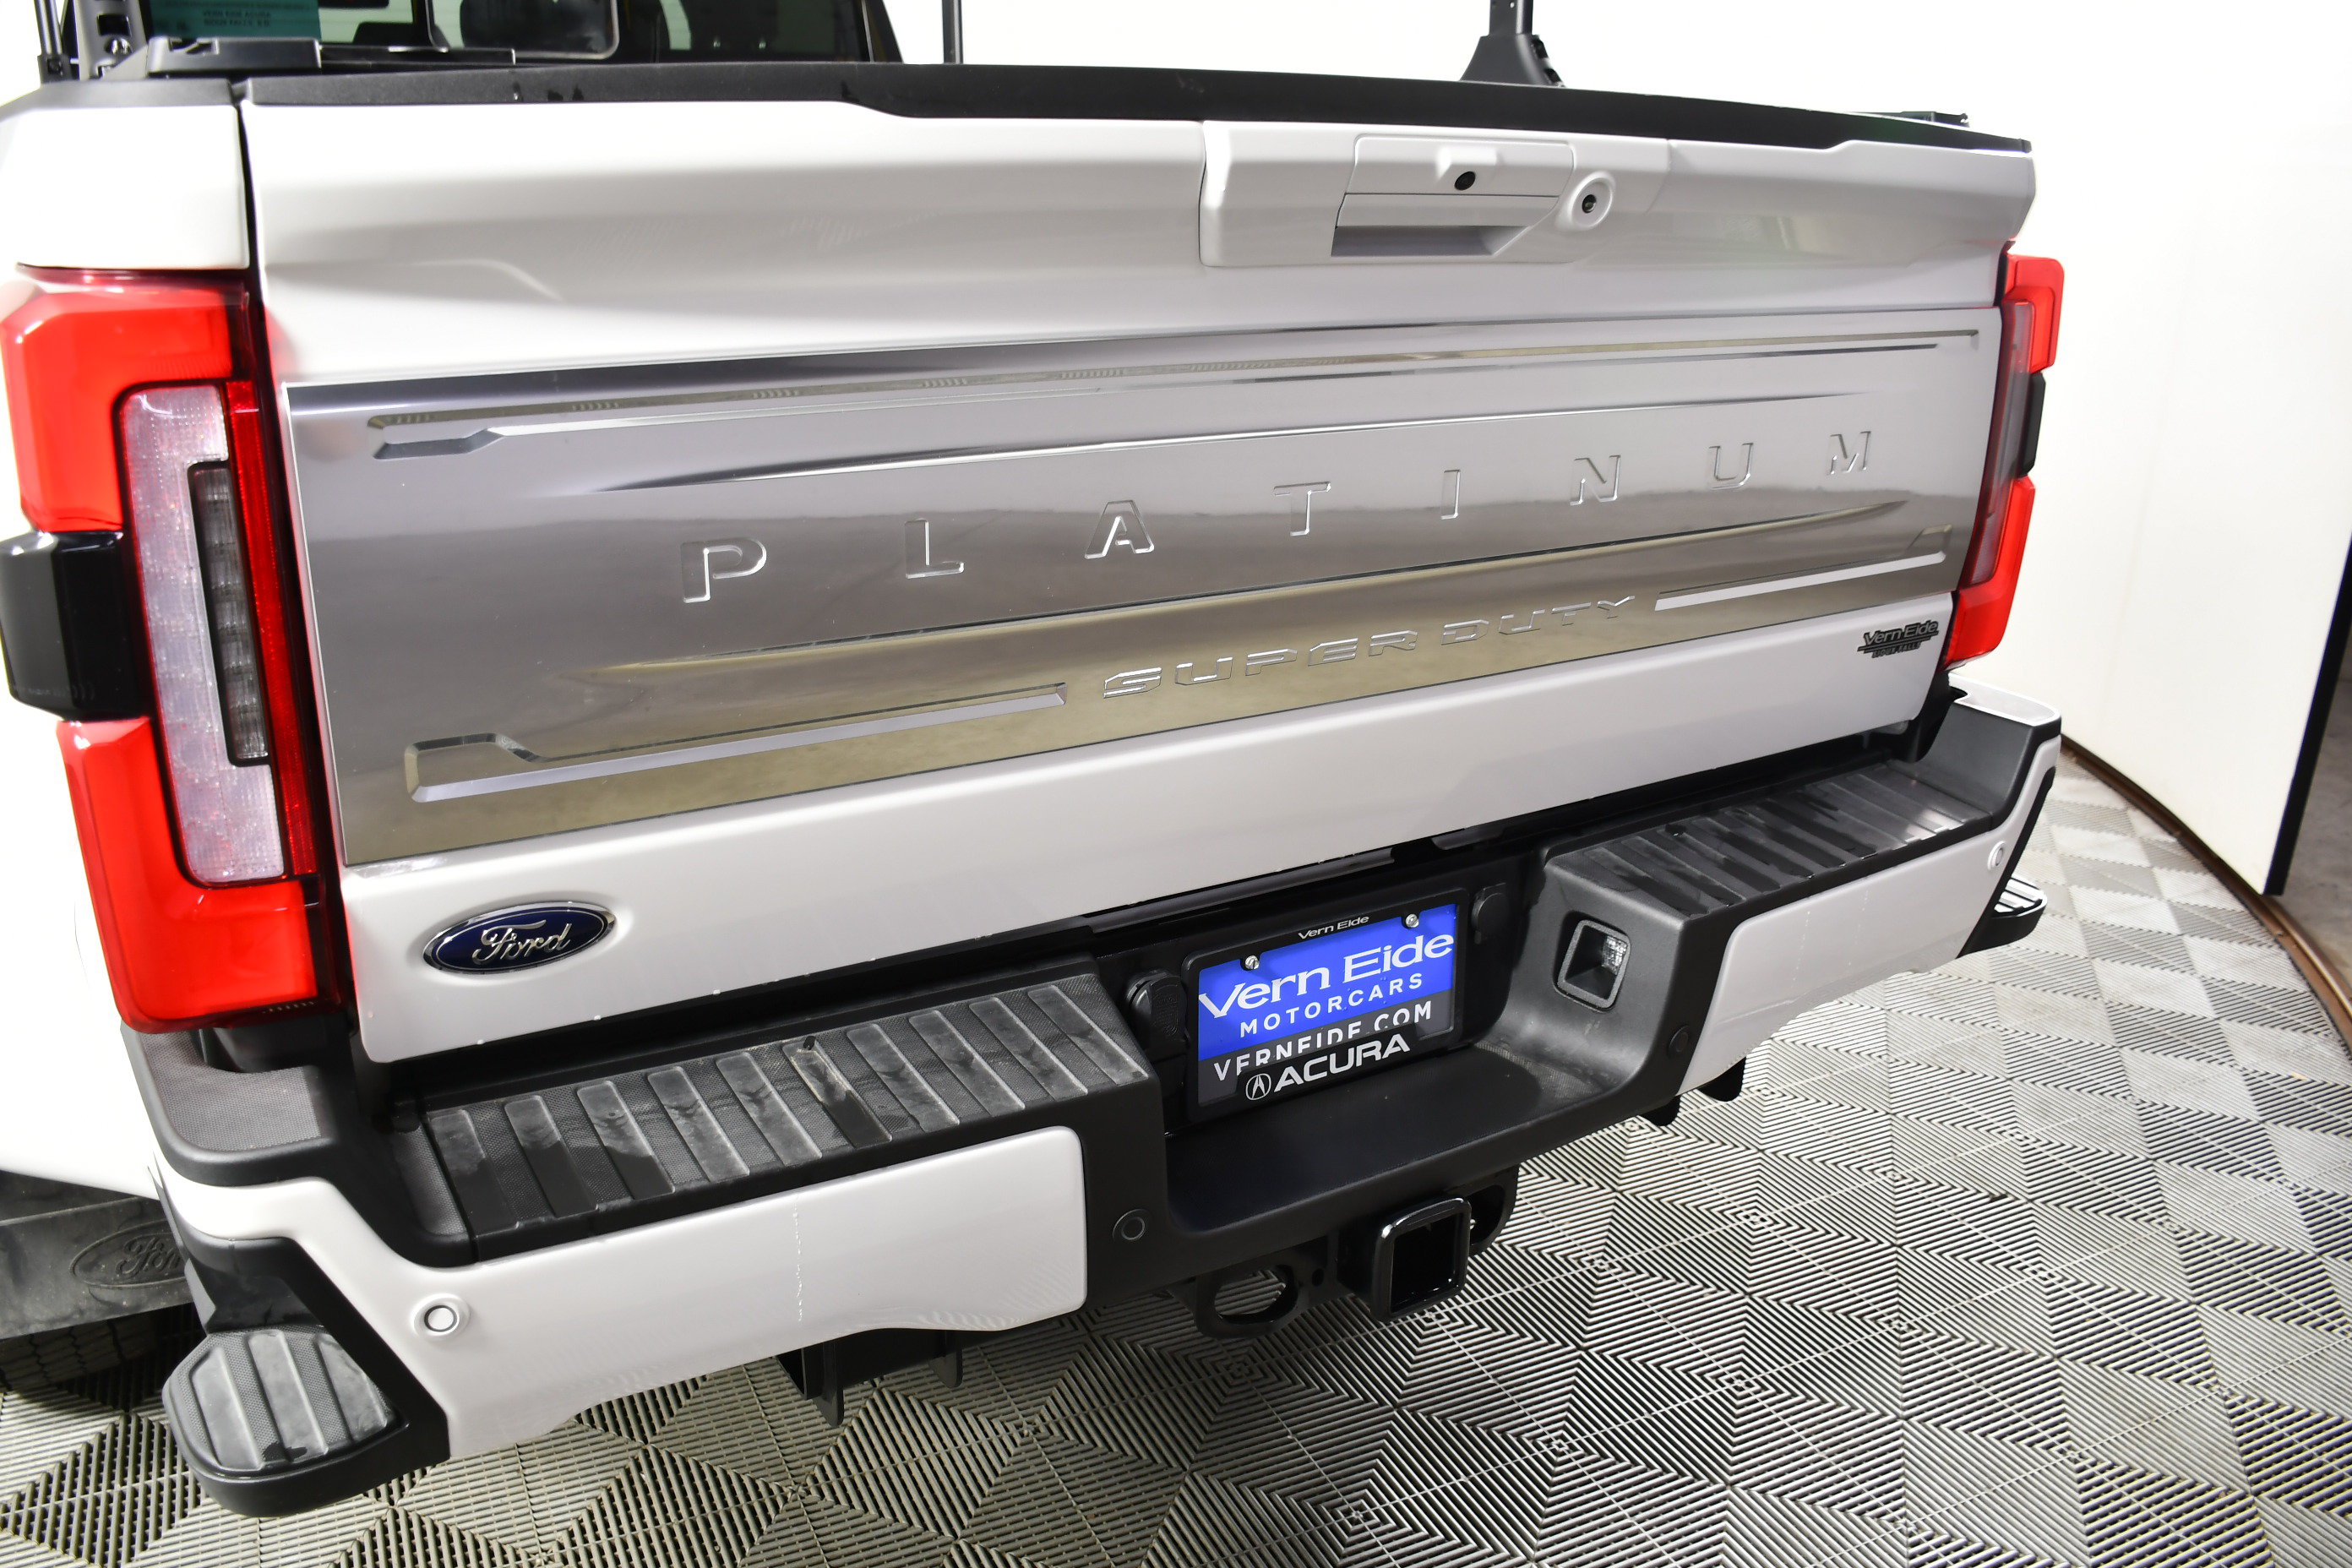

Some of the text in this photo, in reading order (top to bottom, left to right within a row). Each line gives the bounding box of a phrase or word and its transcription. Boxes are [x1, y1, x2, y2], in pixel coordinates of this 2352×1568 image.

[681, 431, 1872, 604] PLATINUM
[1102, 596, 1636, 699] SUPER DUTY
[1863, 620, 1939, 645] Vern Eide
[471, 918, 573, 966] Ford
[1298, 915, 1370, 940] Vern Eide
[1198, 966, 1331, 1019] Vern
[1342, 934, 1455, 984] Eide
[1239, 972, 1423, 1038] MOTORCARS
[1273, 1033, 1412, 1092] ACURA
